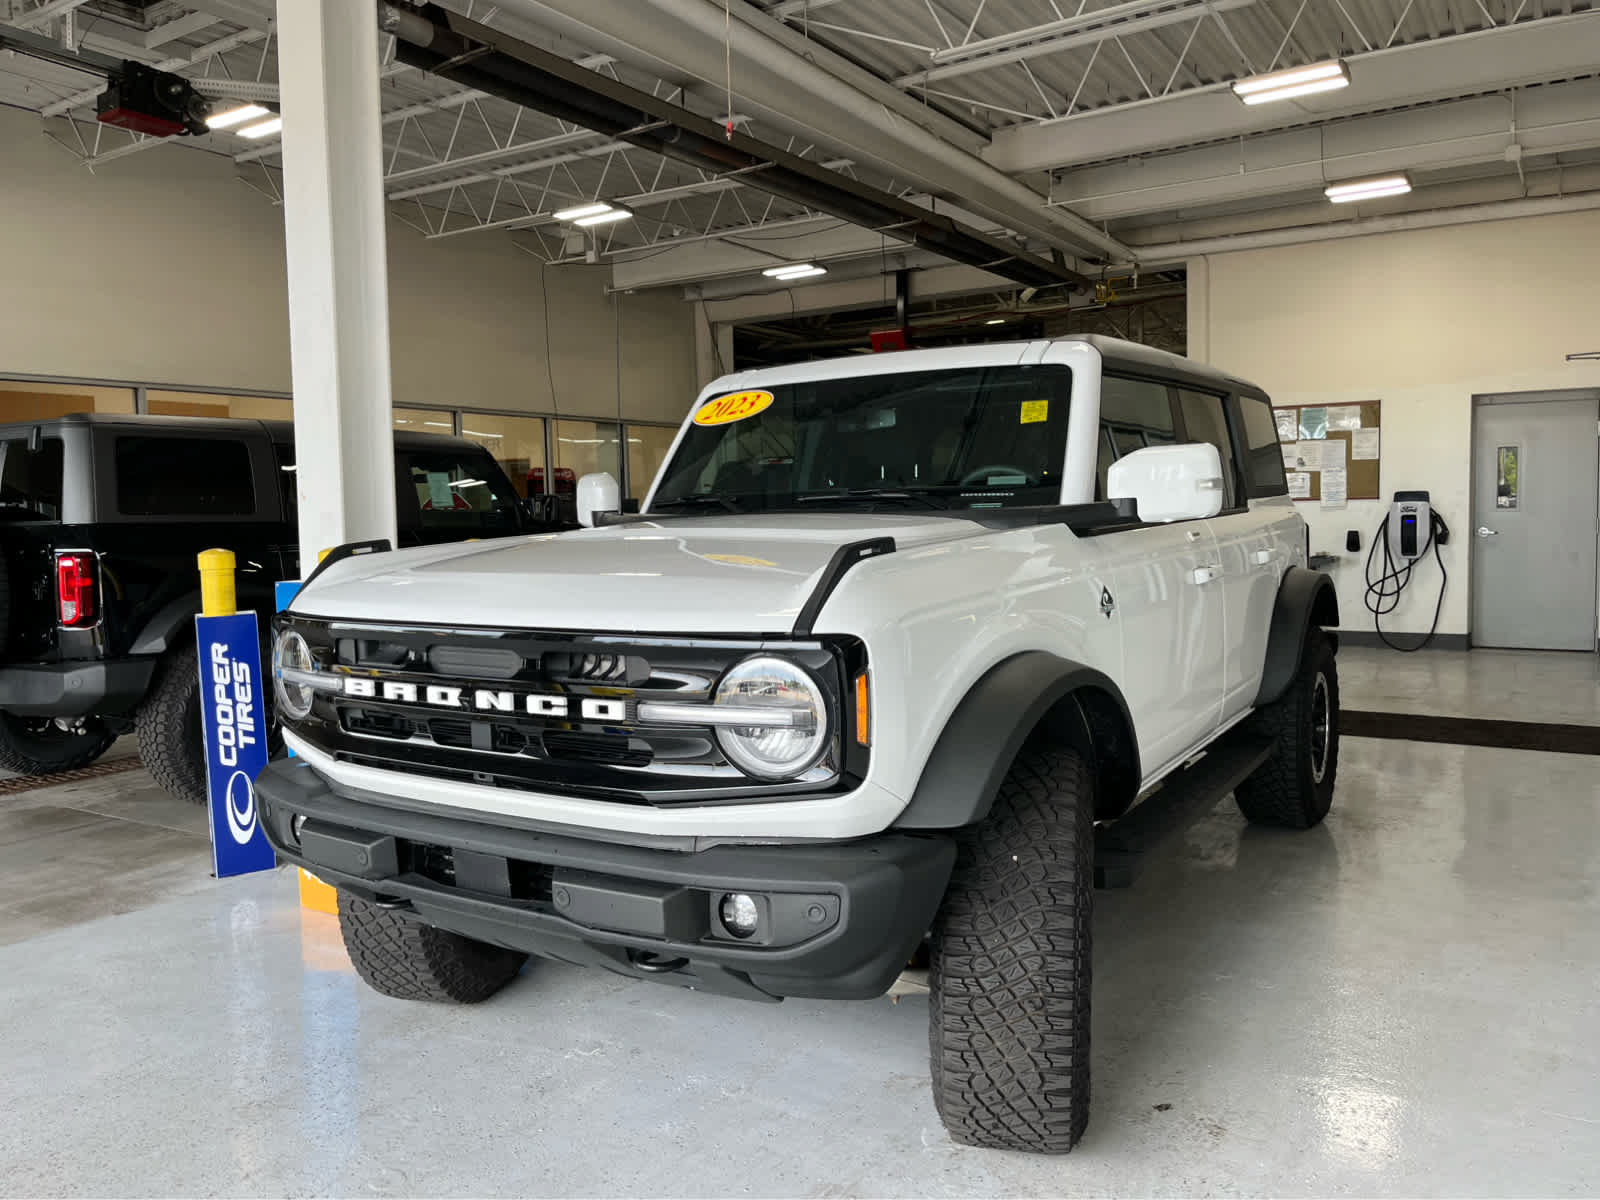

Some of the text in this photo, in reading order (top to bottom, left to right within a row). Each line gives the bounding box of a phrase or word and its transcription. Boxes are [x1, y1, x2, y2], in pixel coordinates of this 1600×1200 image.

[210, 642, 237, 767] COOPER
[232, 661, 256, 749] TIRES
[344, 677, 626, 721] BRONCO
